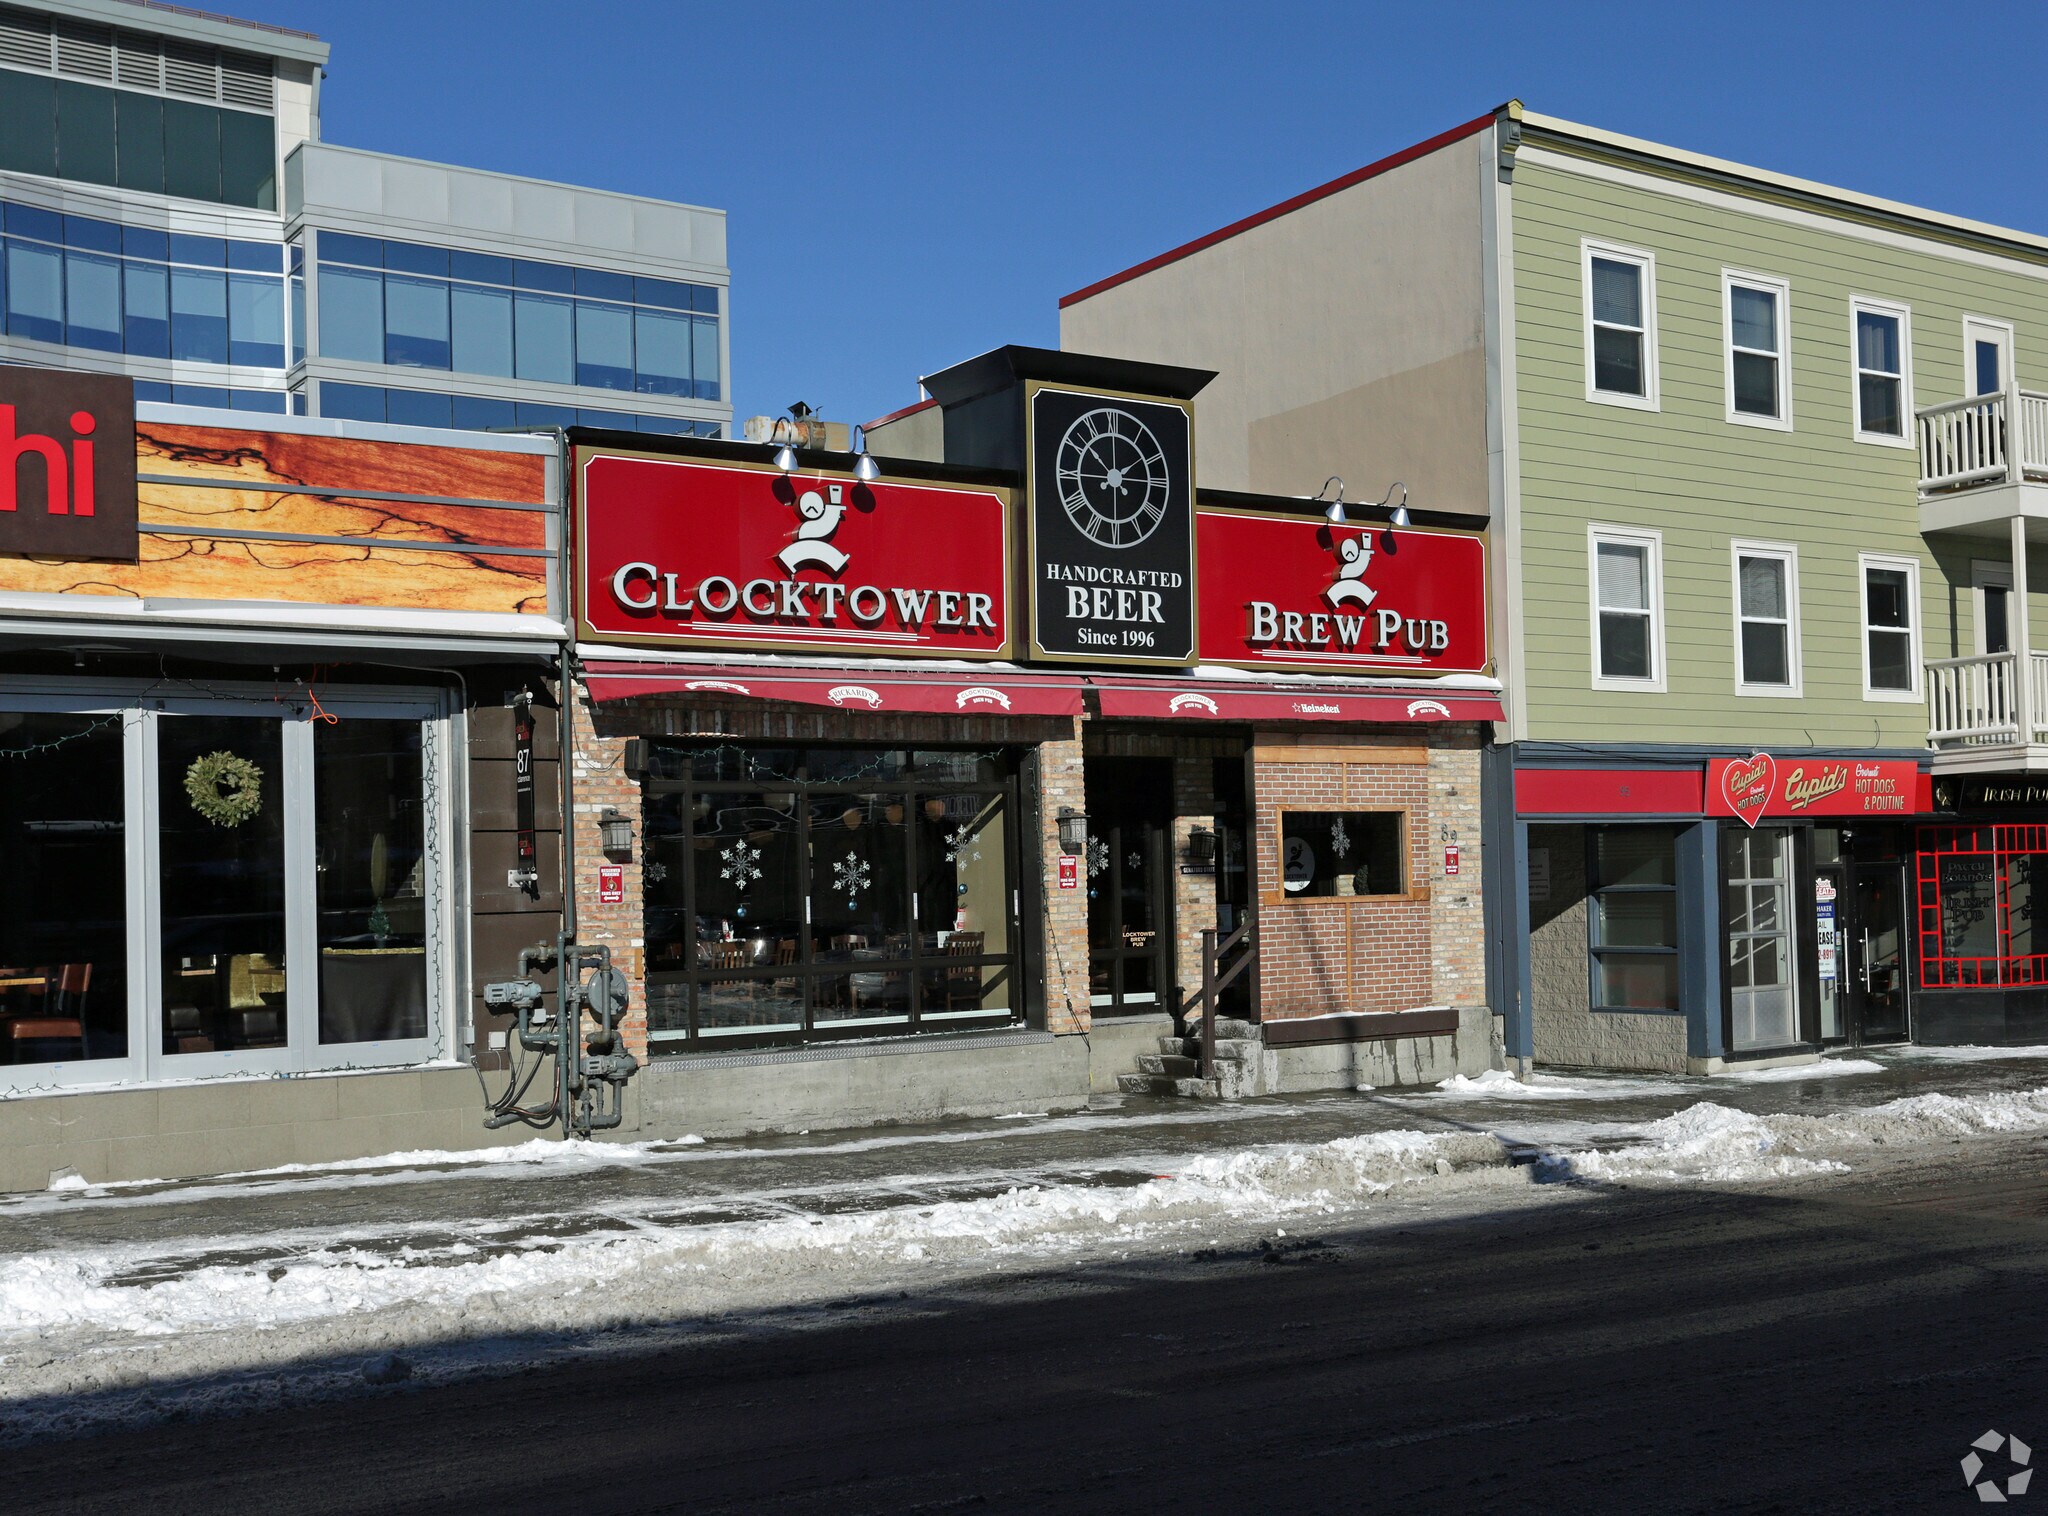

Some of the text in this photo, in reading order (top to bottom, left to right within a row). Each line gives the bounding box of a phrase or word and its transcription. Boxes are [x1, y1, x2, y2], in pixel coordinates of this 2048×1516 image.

[1046, 563, 1182, 588] HANDCRAFTED
[612, 561, 997, 628] CLOCKTOWER
[1065, 585, 1166, 623] BEER
[1250, 601, 1449, 649] BREW PUB
[1078, 627, 1155, 647] Since 1996
[833, 687, 874, 699] RICKARD'S
[960, 689, 1004, 700] CLOCKTOWER
[1174, 694, 1212, 705] CLOCKTOWER
[1300, 703, 1340, 714] Heineken
[517, 748, 530, 773] 87
[1731, 761, 1766, 795] Cupid's
[1855, 778, 1896, 793] HOT DOGS
[1784, 764, 1848, 811] Cupid's
[1984, 786, 2048, 802] IRISH PU
[1737, 792, 1766, 811] HOT DOGS
[1863, 796, 1905, 810] & POUTINE
[1945, 894, 1990, 911] IRISH
[1952, 909, 1986, 922] PUB
